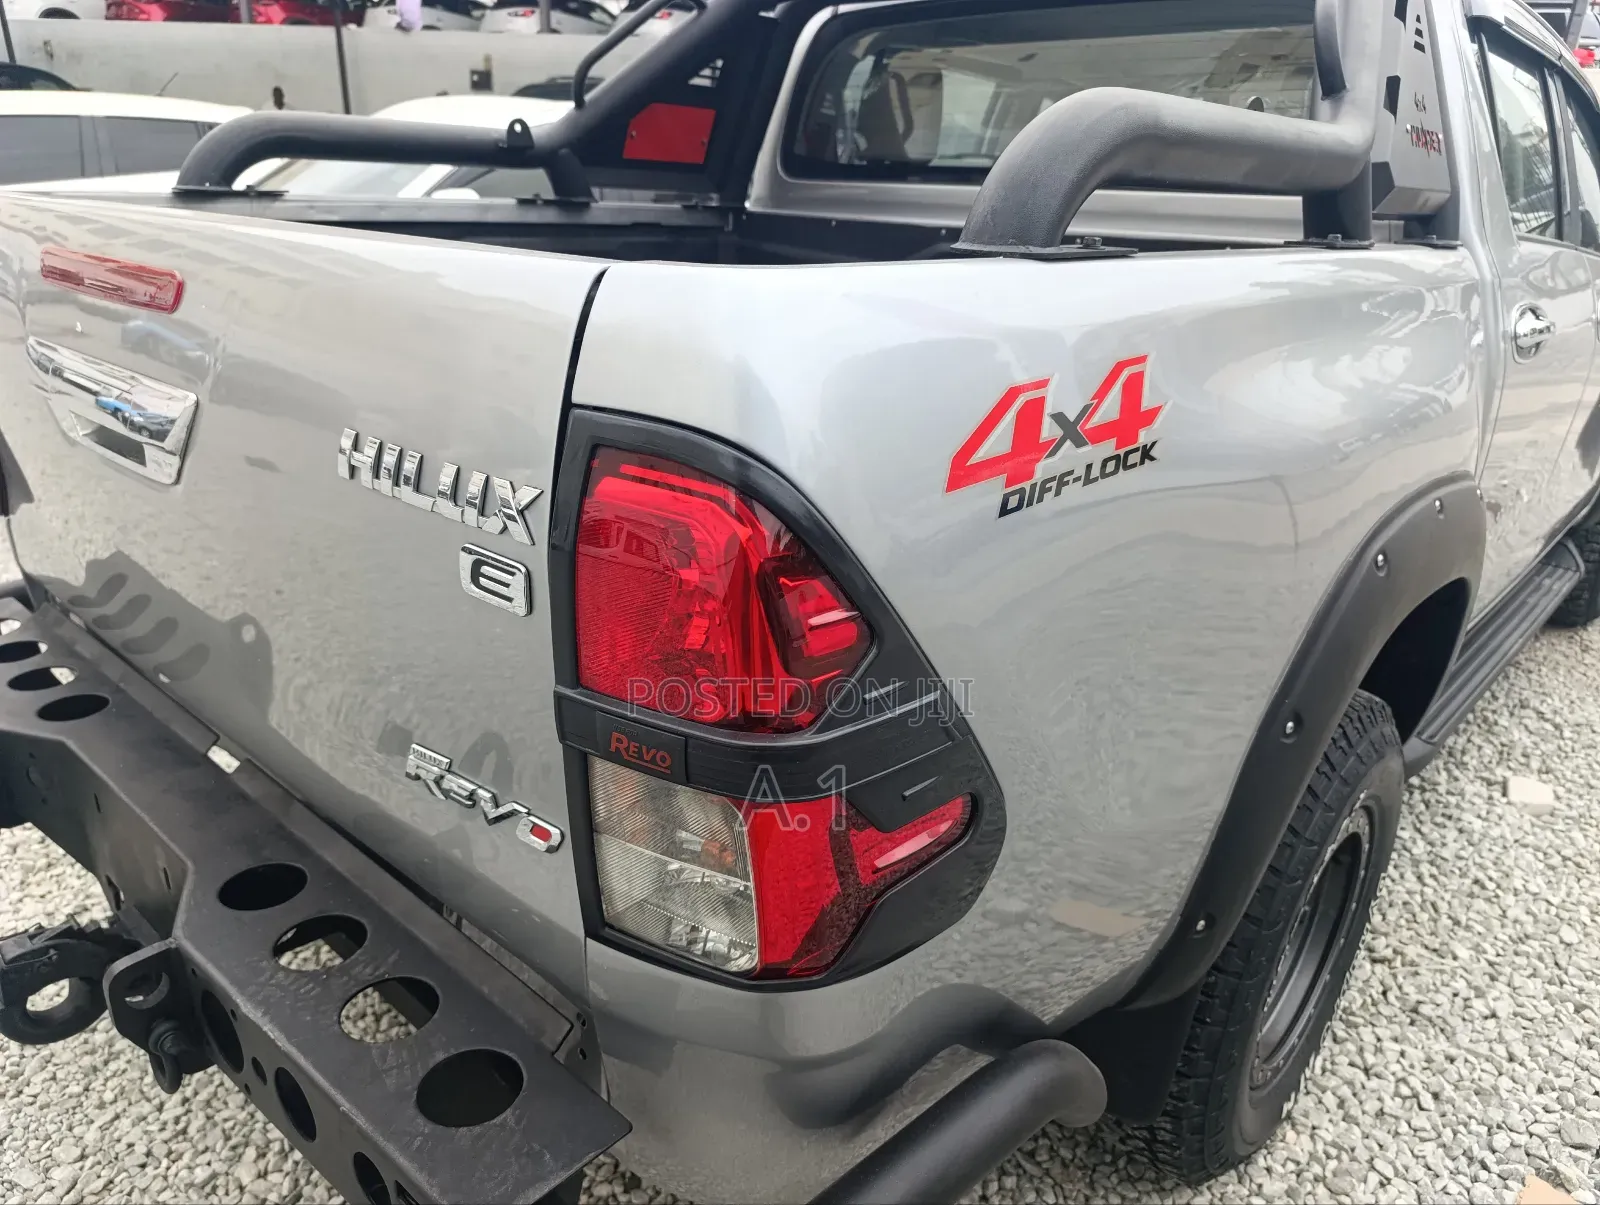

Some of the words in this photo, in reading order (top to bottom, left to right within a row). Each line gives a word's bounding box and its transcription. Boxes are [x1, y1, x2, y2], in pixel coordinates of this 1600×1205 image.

[944, 353, 1166, 494] 4x4
[338, 427, 544, 546] HILUX
[997, 439, 1160, 519] DIFF-LOCK
[610, 732, 672, 771] REVO
[405, 753, 564, 853] REVO
